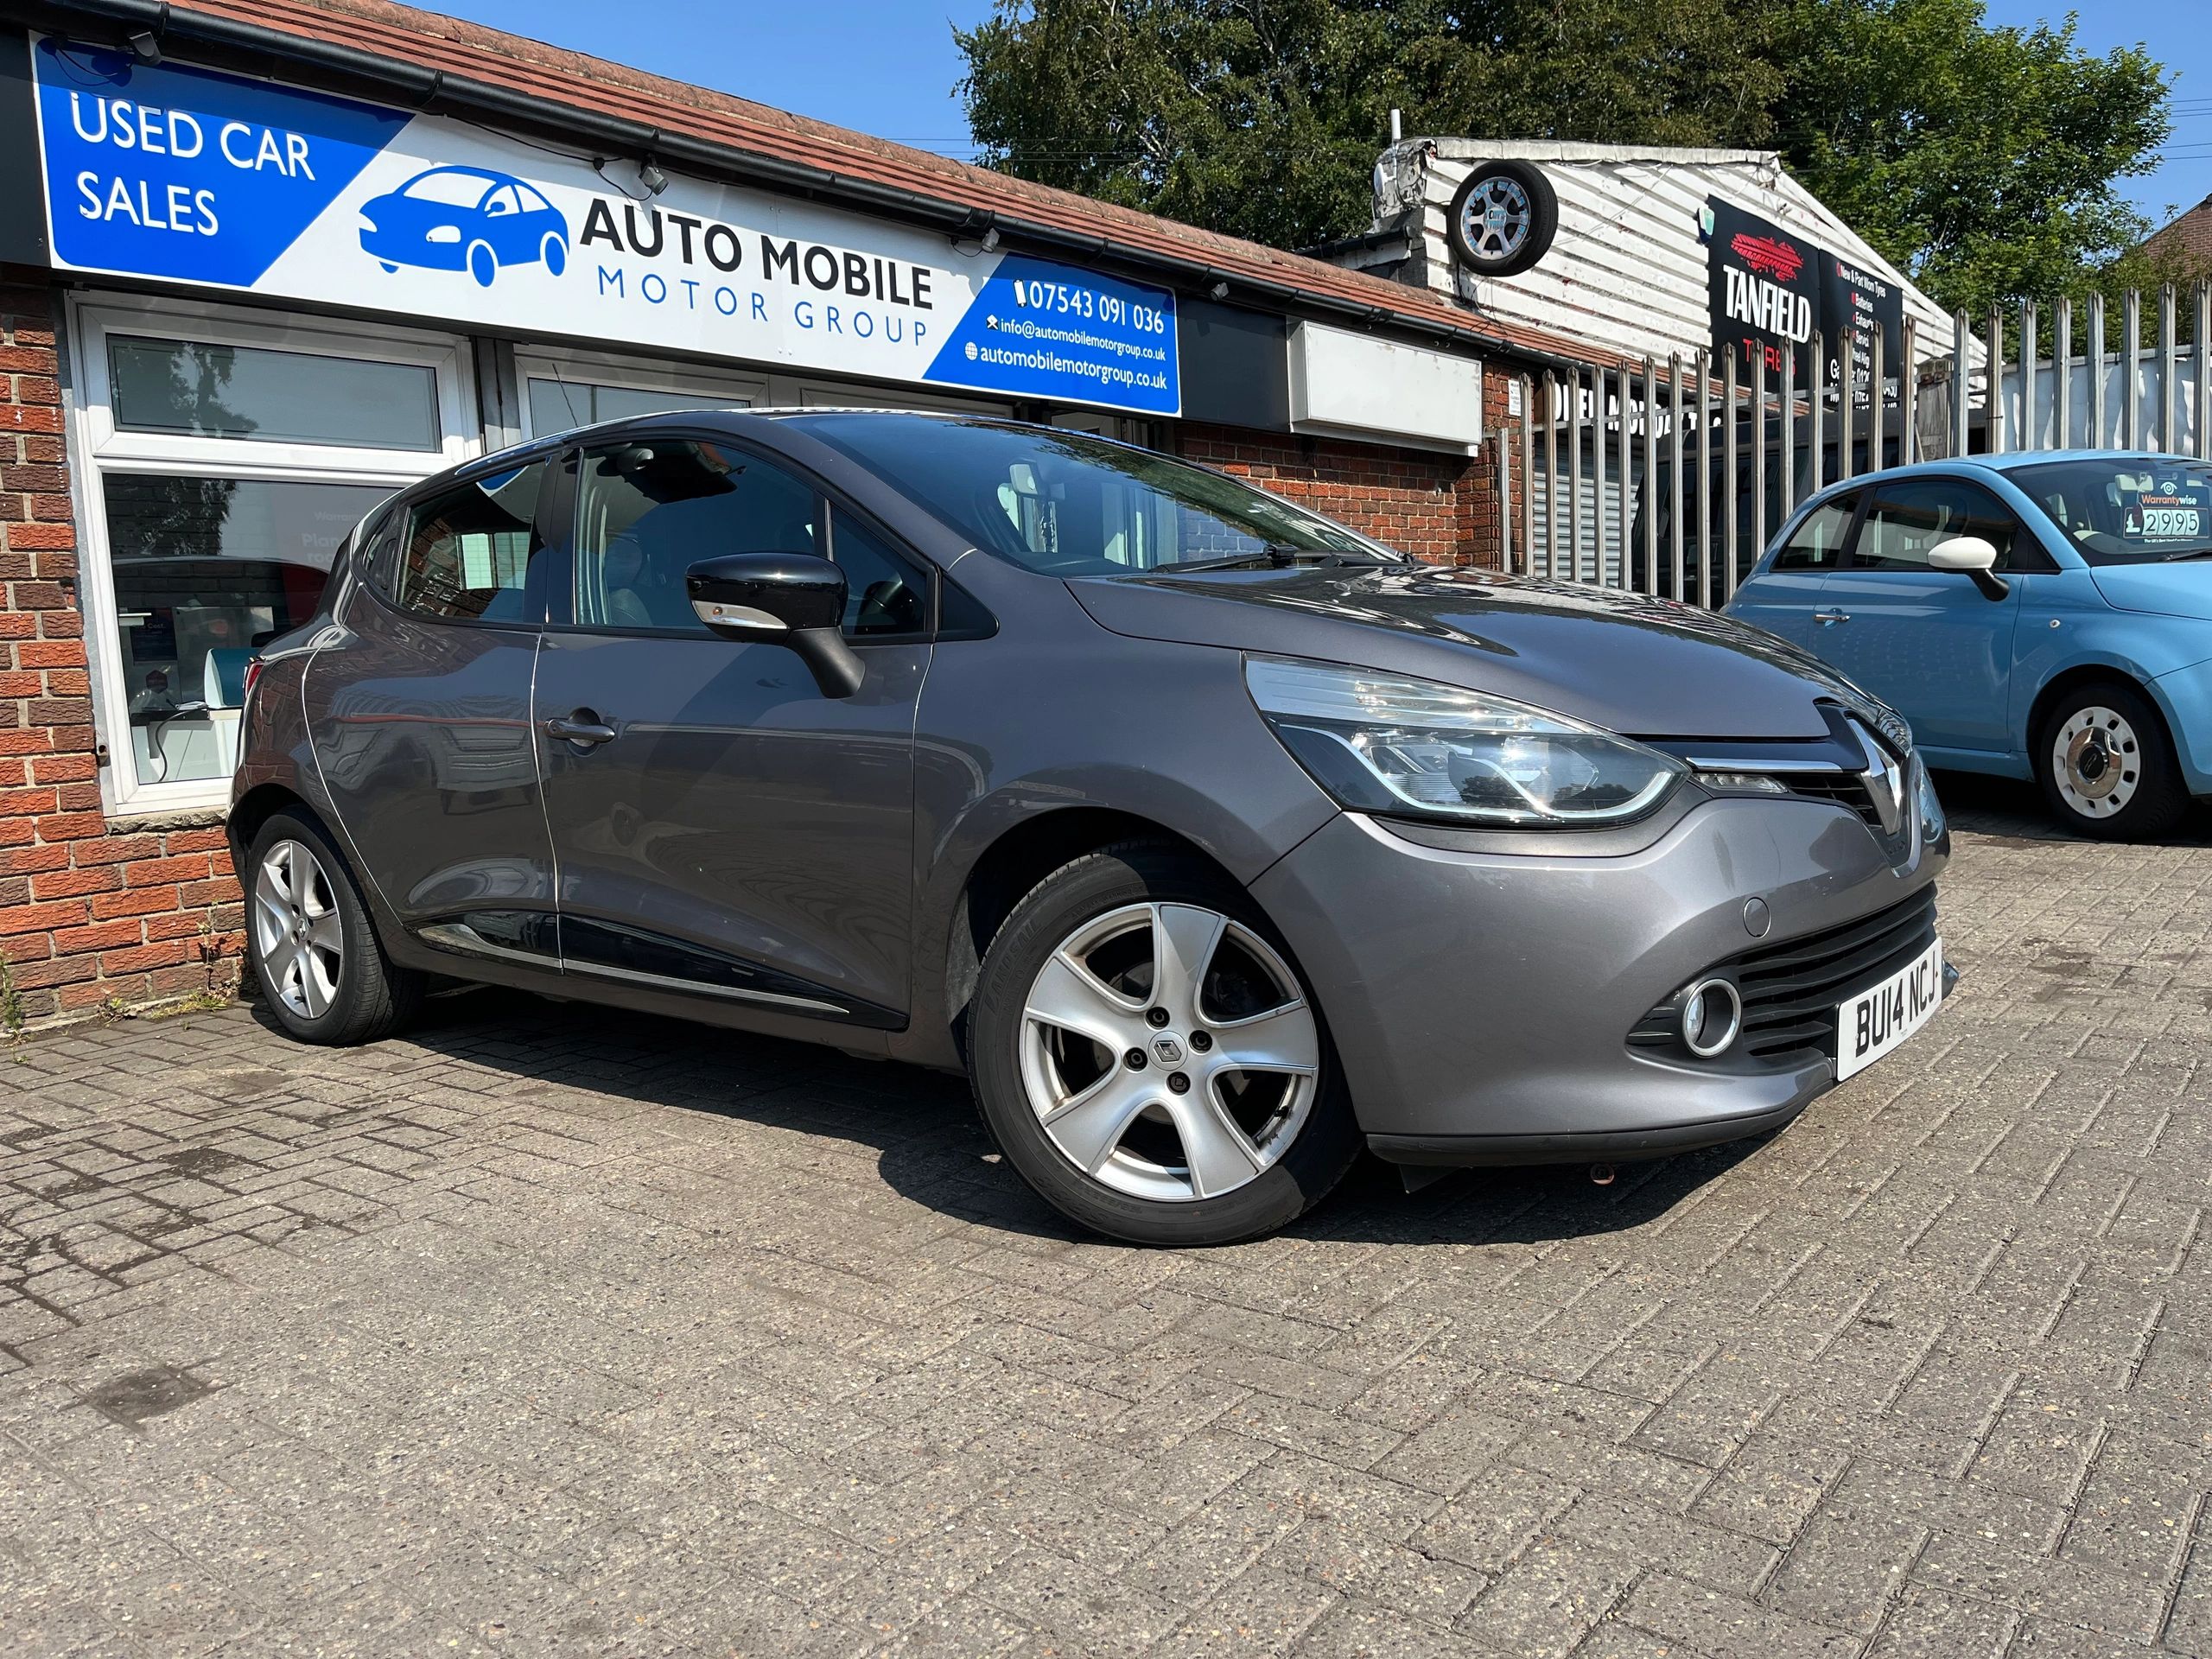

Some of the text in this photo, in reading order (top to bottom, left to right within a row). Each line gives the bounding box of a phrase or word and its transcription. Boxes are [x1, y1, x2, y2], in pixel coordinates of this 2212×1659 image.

[70, 92, 316, 181] USED CAR
[77, 171, 219, 236] SALES
[580, 198, 933, 310] AUTO MOBILE
[598, 265, 926, 346] MOTOR GROUP
[1029, 281, 1165, 334] 07543 091 036
[1722, 264, 1811, 344] TANFIELD
[981, 346, 1166, 390] automobilemotorgroup.co.uk
[1001, 318, 1166, 361] info@automobilemotorgroup.co.uk
[1743, 338, 1797, 376] TRE
[2141, 494, 2197, 506] Warrantywise
[1855, 950, 1936, 1058] BU14 NCJ
